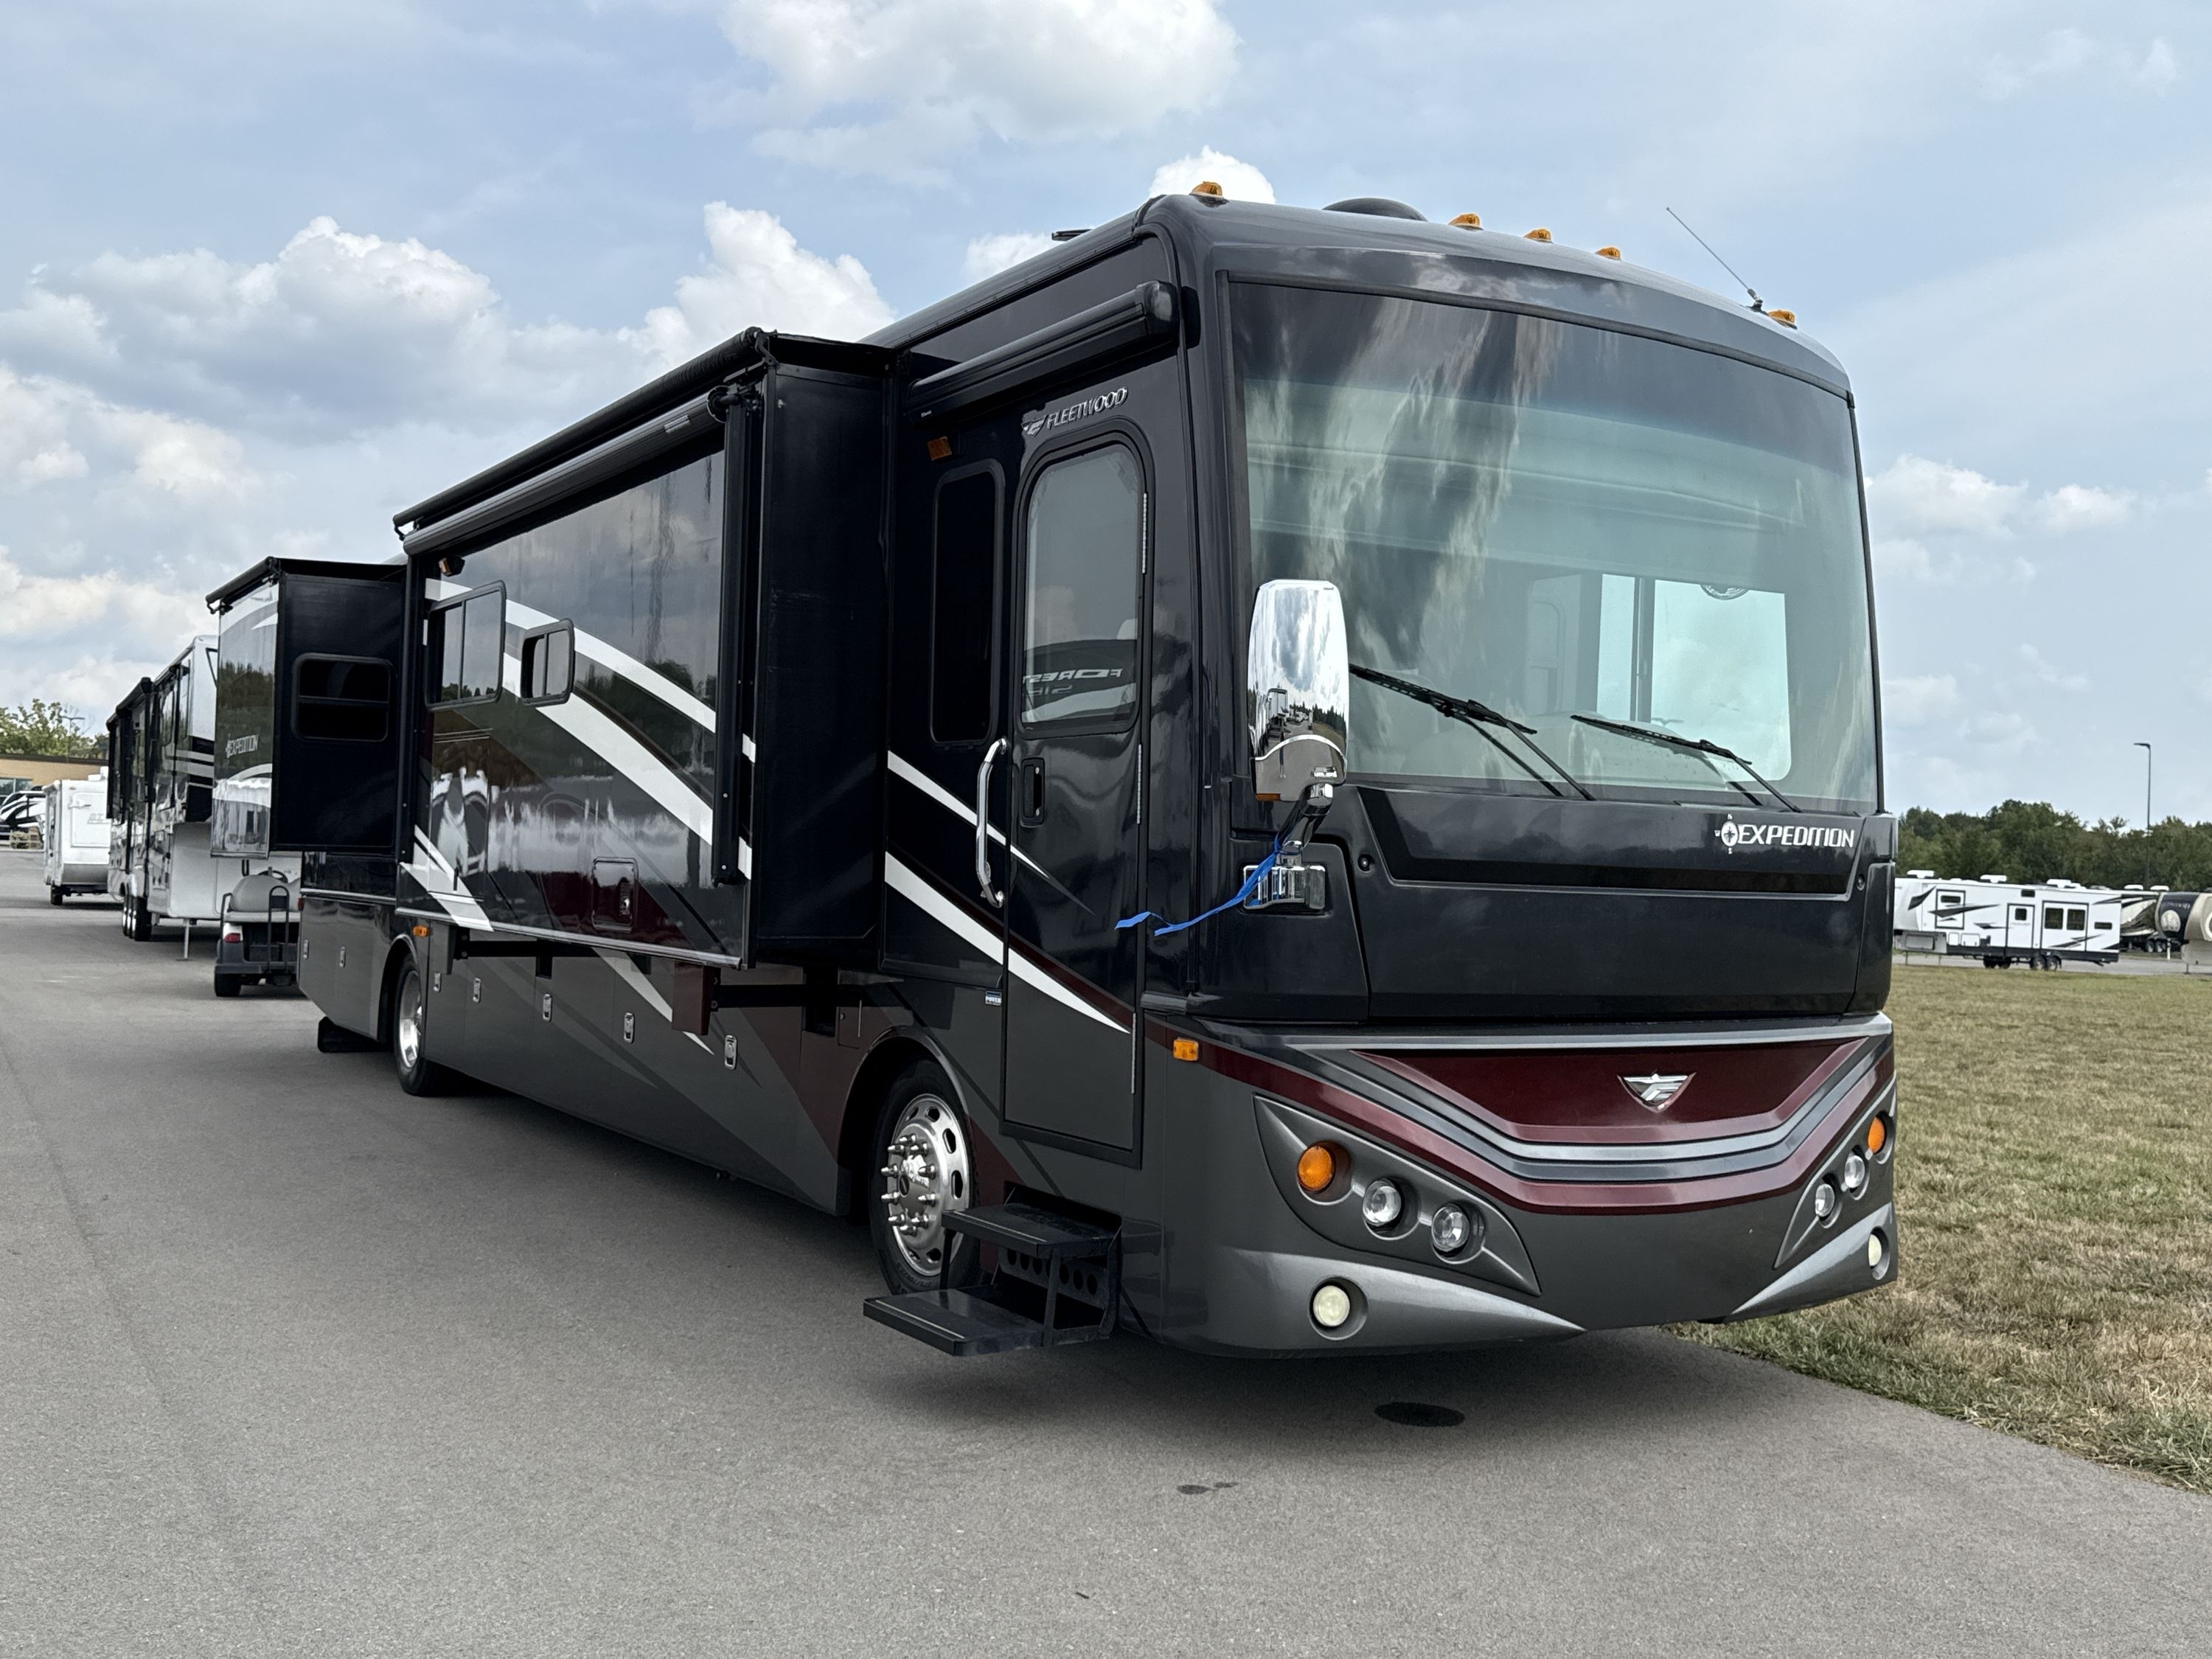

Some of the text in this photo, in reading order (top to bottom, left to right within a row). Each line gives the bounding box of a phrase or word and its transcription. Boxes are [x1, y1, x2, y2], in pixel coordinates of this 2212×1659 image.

[1046, 386, 1128, 430] FLEETWOOD
[229, 734, 259, 757] EXPEDITION
[1737, 824, 1854, 848] EXPEDITION
